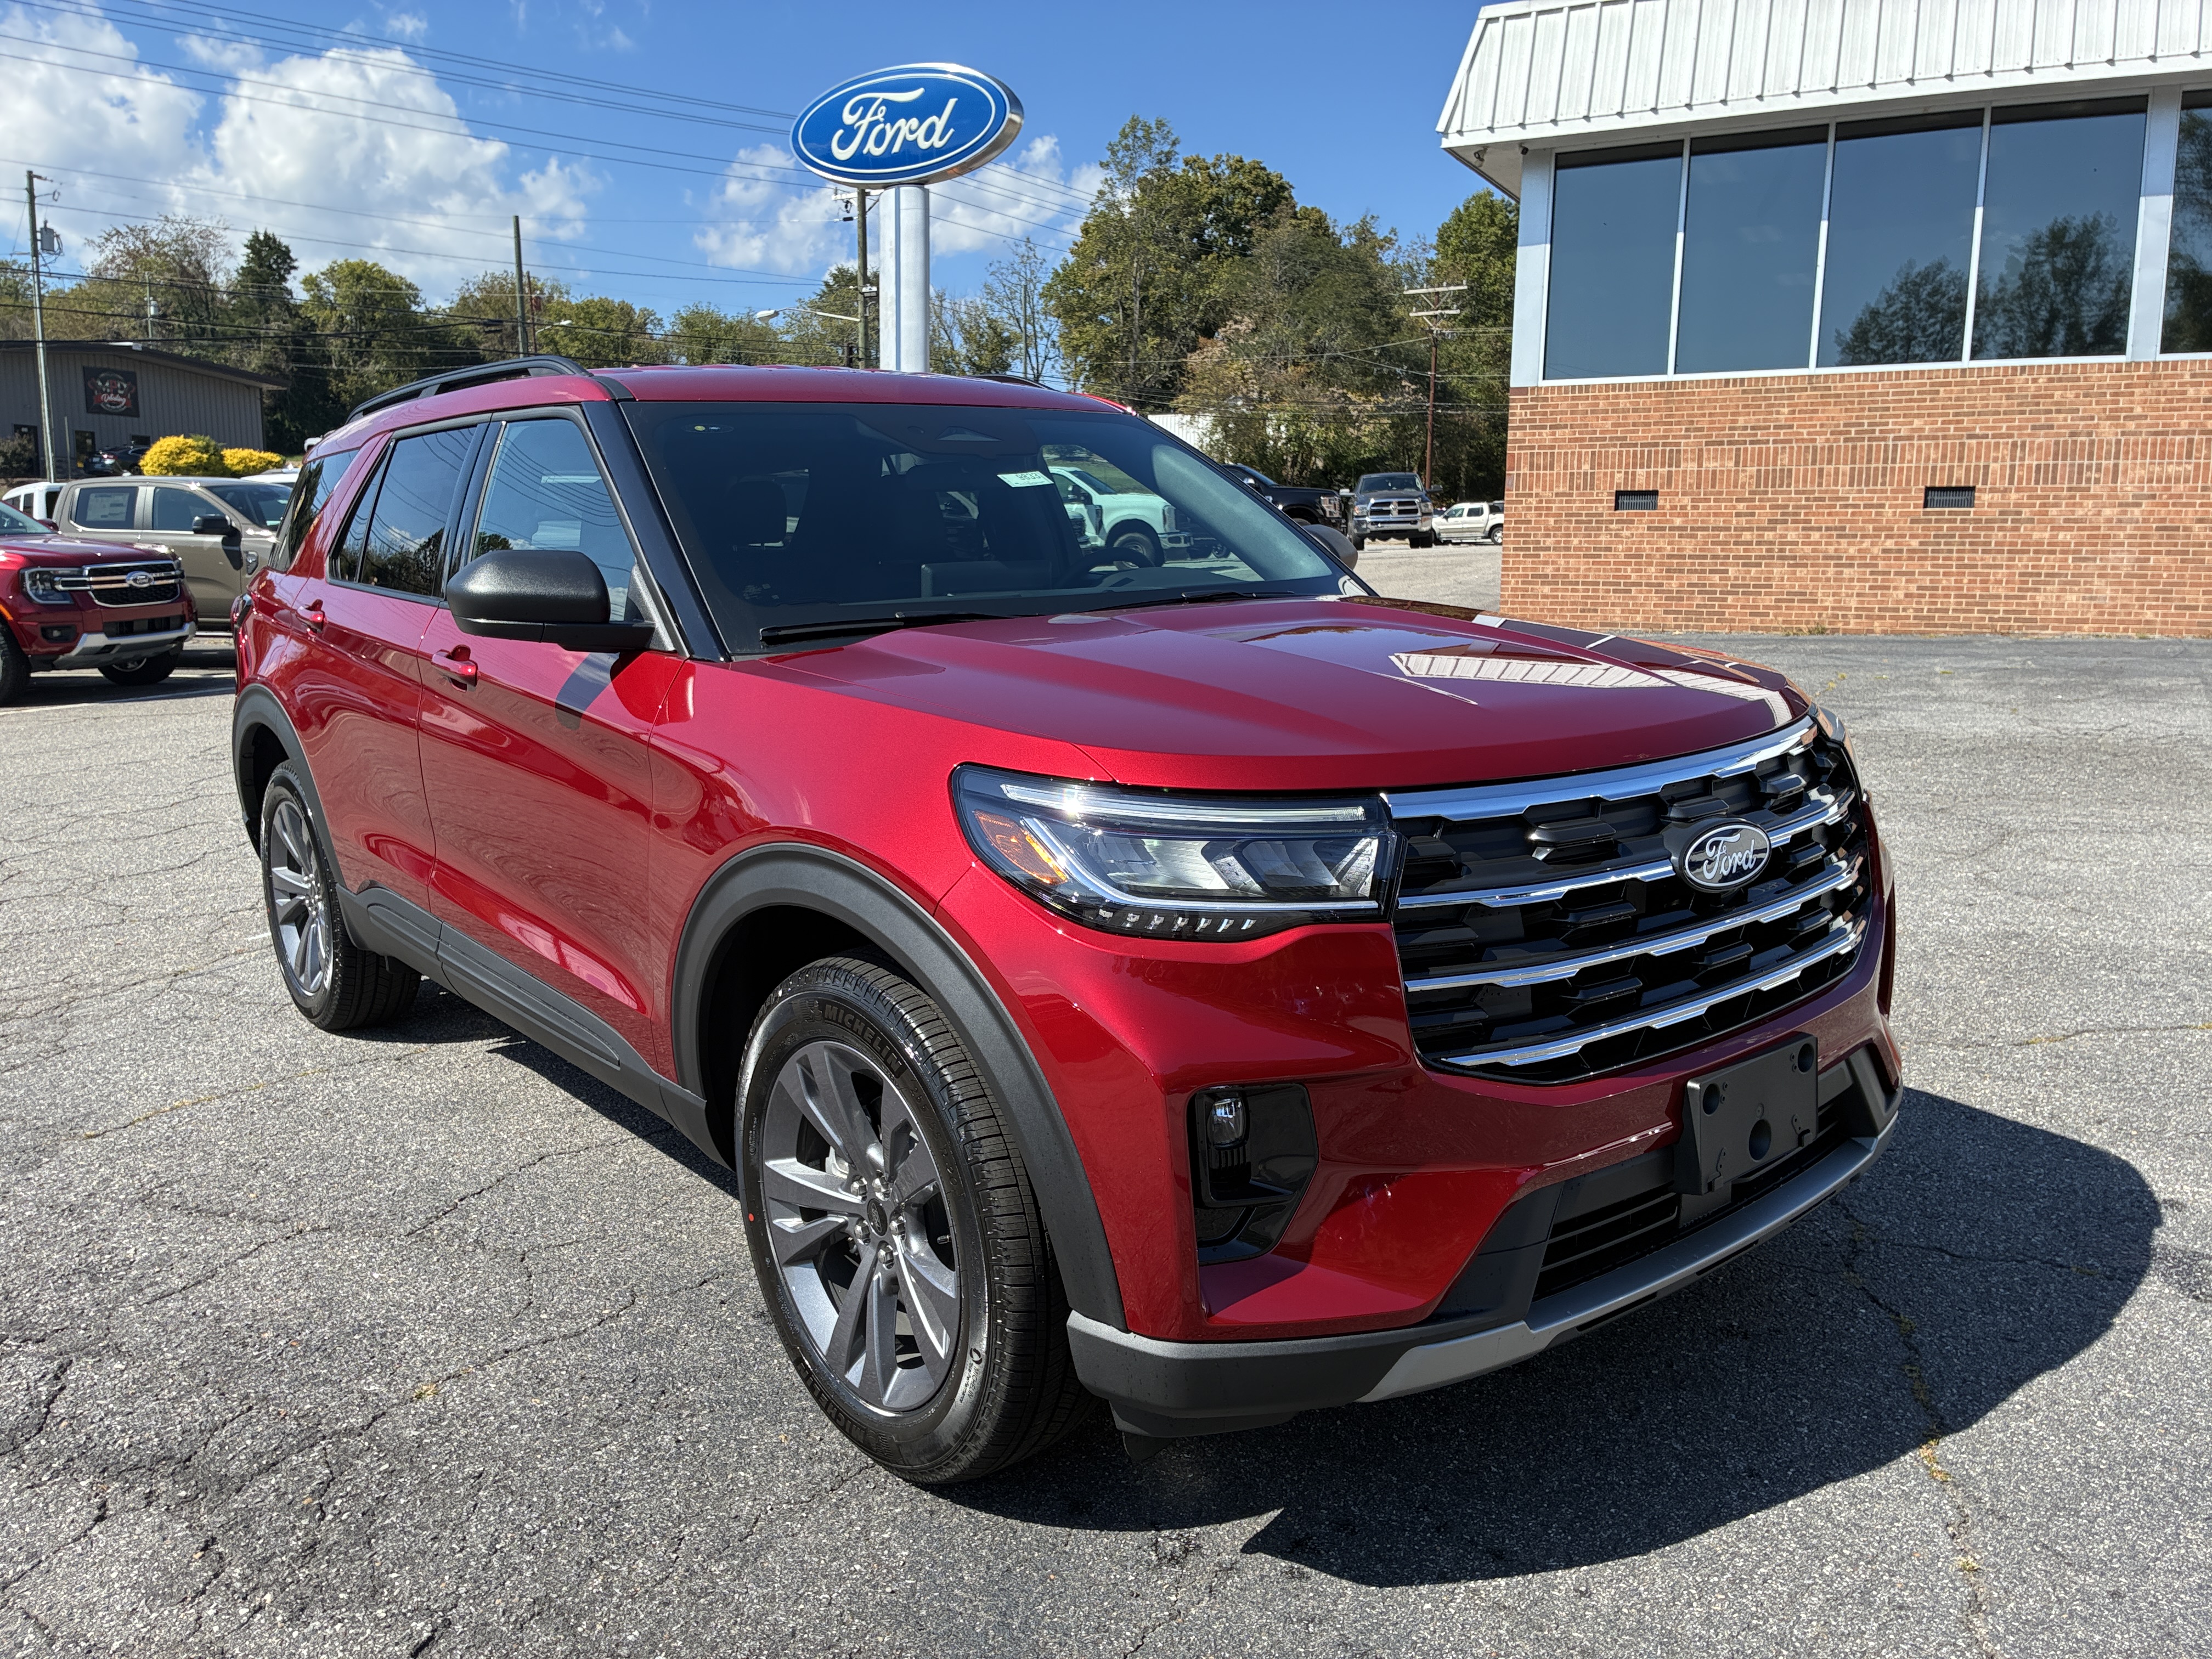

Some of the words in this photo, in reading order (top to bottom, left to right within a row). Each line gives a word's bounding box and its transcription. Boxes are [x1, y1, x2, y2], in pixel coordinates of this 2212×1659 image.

[831, 87, 958, 161] Ford
[1703, 833, 1756, 879] Ford
[824, 1003, 902, 1073] MICHELIN
[796, 1362, 865, 1446] MICHELIN
[968, 1366, 979, 1399] MICHELIN
